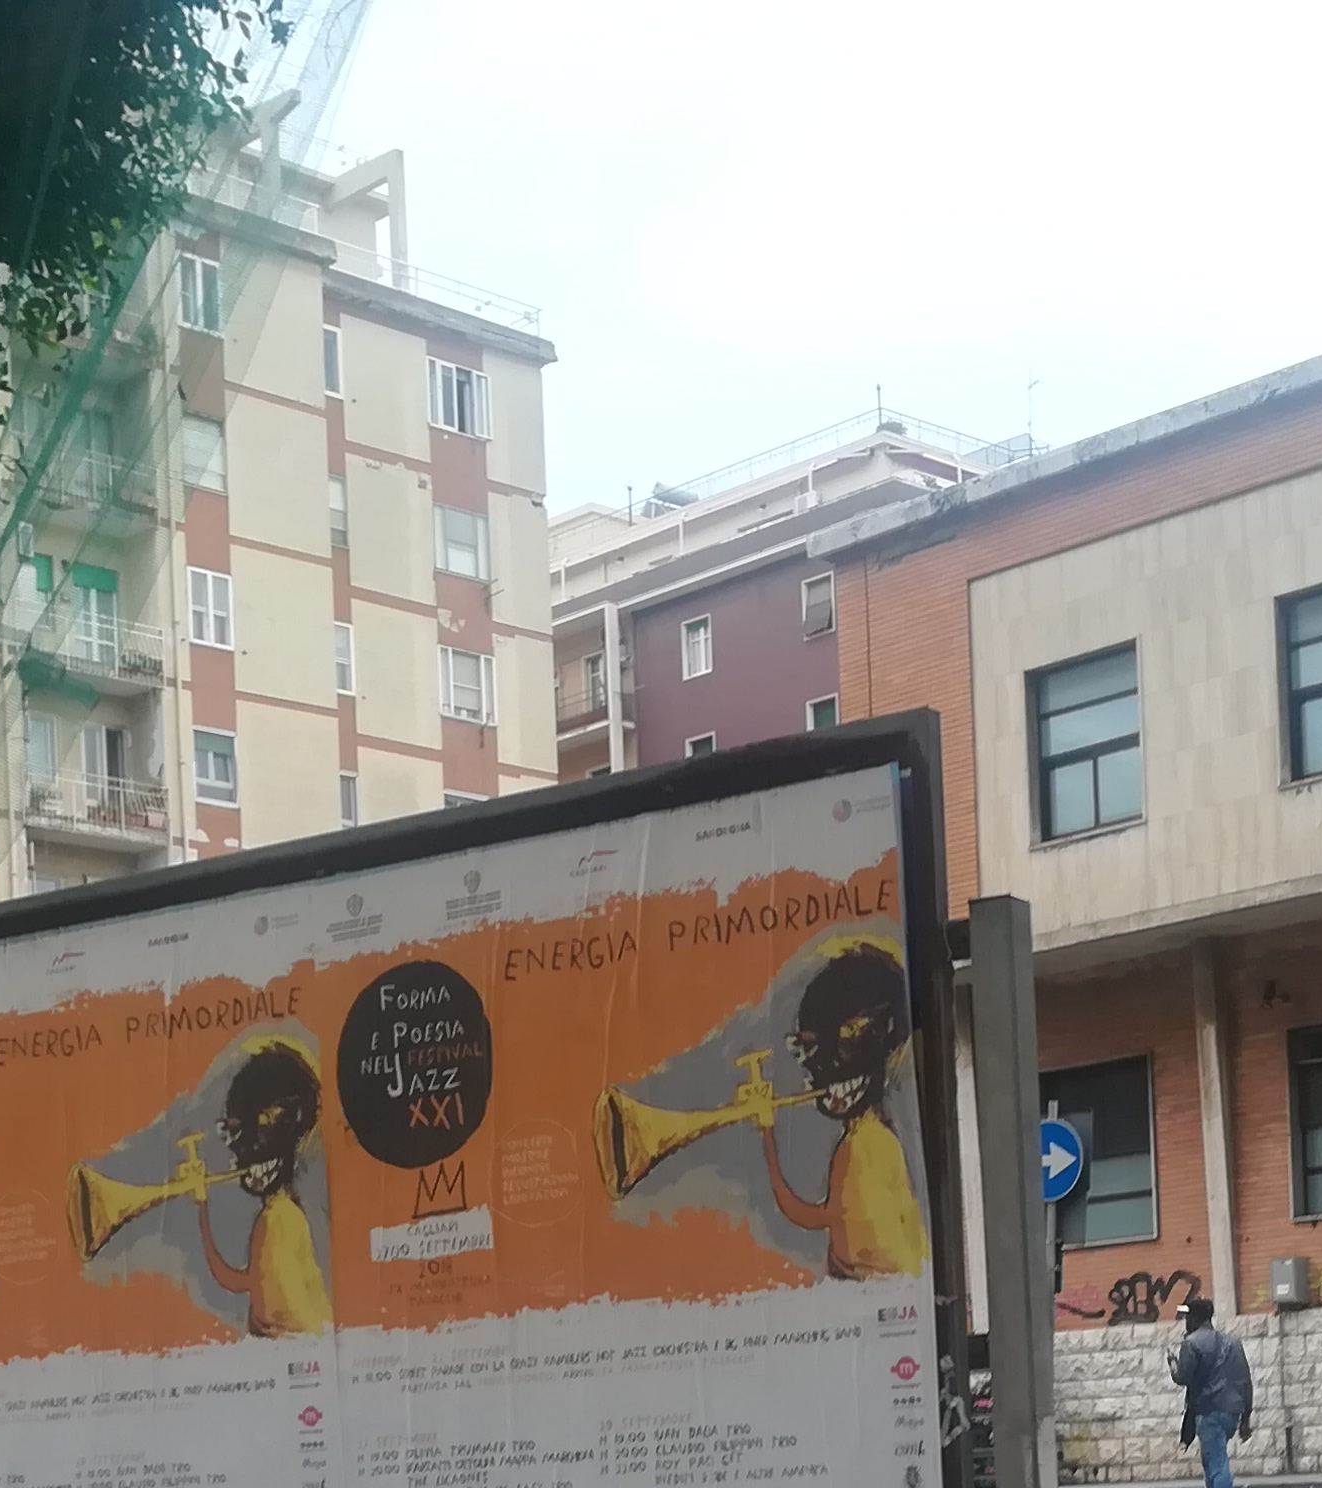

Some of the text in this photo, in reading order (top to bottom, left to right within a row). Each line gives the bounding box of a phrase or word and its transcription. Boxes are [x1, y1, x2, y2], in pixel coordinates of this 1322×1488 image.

[504, 879, 895, 982] ENERGIA PRIMORDIALE
[379, 984, 452, 1012] FORMA
[126, 987, 302, 1044] PRIMORDIALE
[370, 1020, 465, 1052] E POESIA
[406, 1040, 483, 1066] FESTIVAL
[387, 1053, 462, 1098] JAZZ
[408, 1092, 465, 1130] XXI
[407, 1222, 459, 1238] CAGLIARI
[418, 1234, 491, 1257] SETTEMBRE
[492, 1360, 505, 1372] LA
[771, 1435, 798, 1449] TRIO
